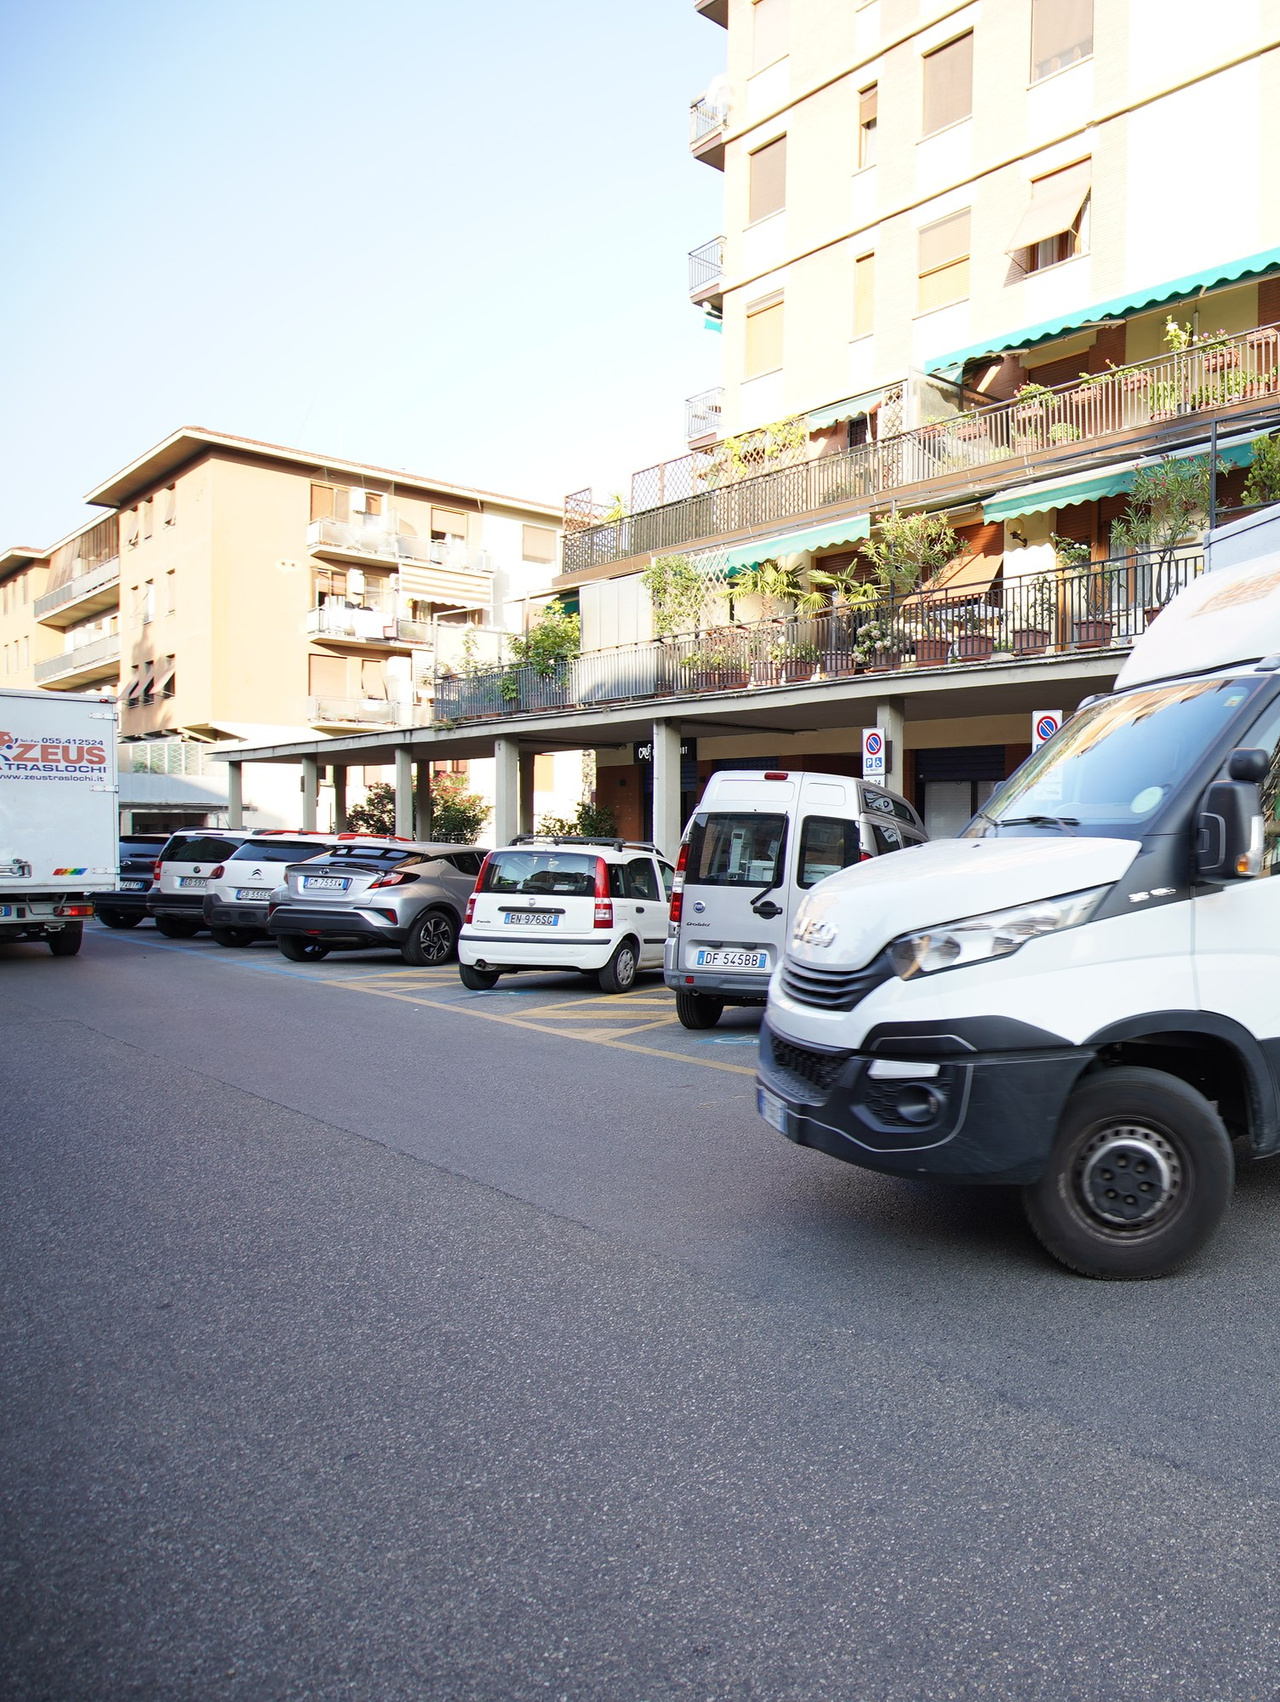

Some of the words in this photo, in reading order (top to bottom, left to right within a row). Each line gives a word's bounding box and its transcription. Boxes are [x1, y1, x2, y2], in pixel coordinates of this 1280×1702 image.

[41, 737, 104, 746] 055.412524
[12, 743, 107, 765] ZEUS
[4, 763, 107, 773] TRASLOCHI
[510, 914, 522, 924] EN
[705, 952, 720, 964] DF
[722, 953, 759, 966] 545BB
